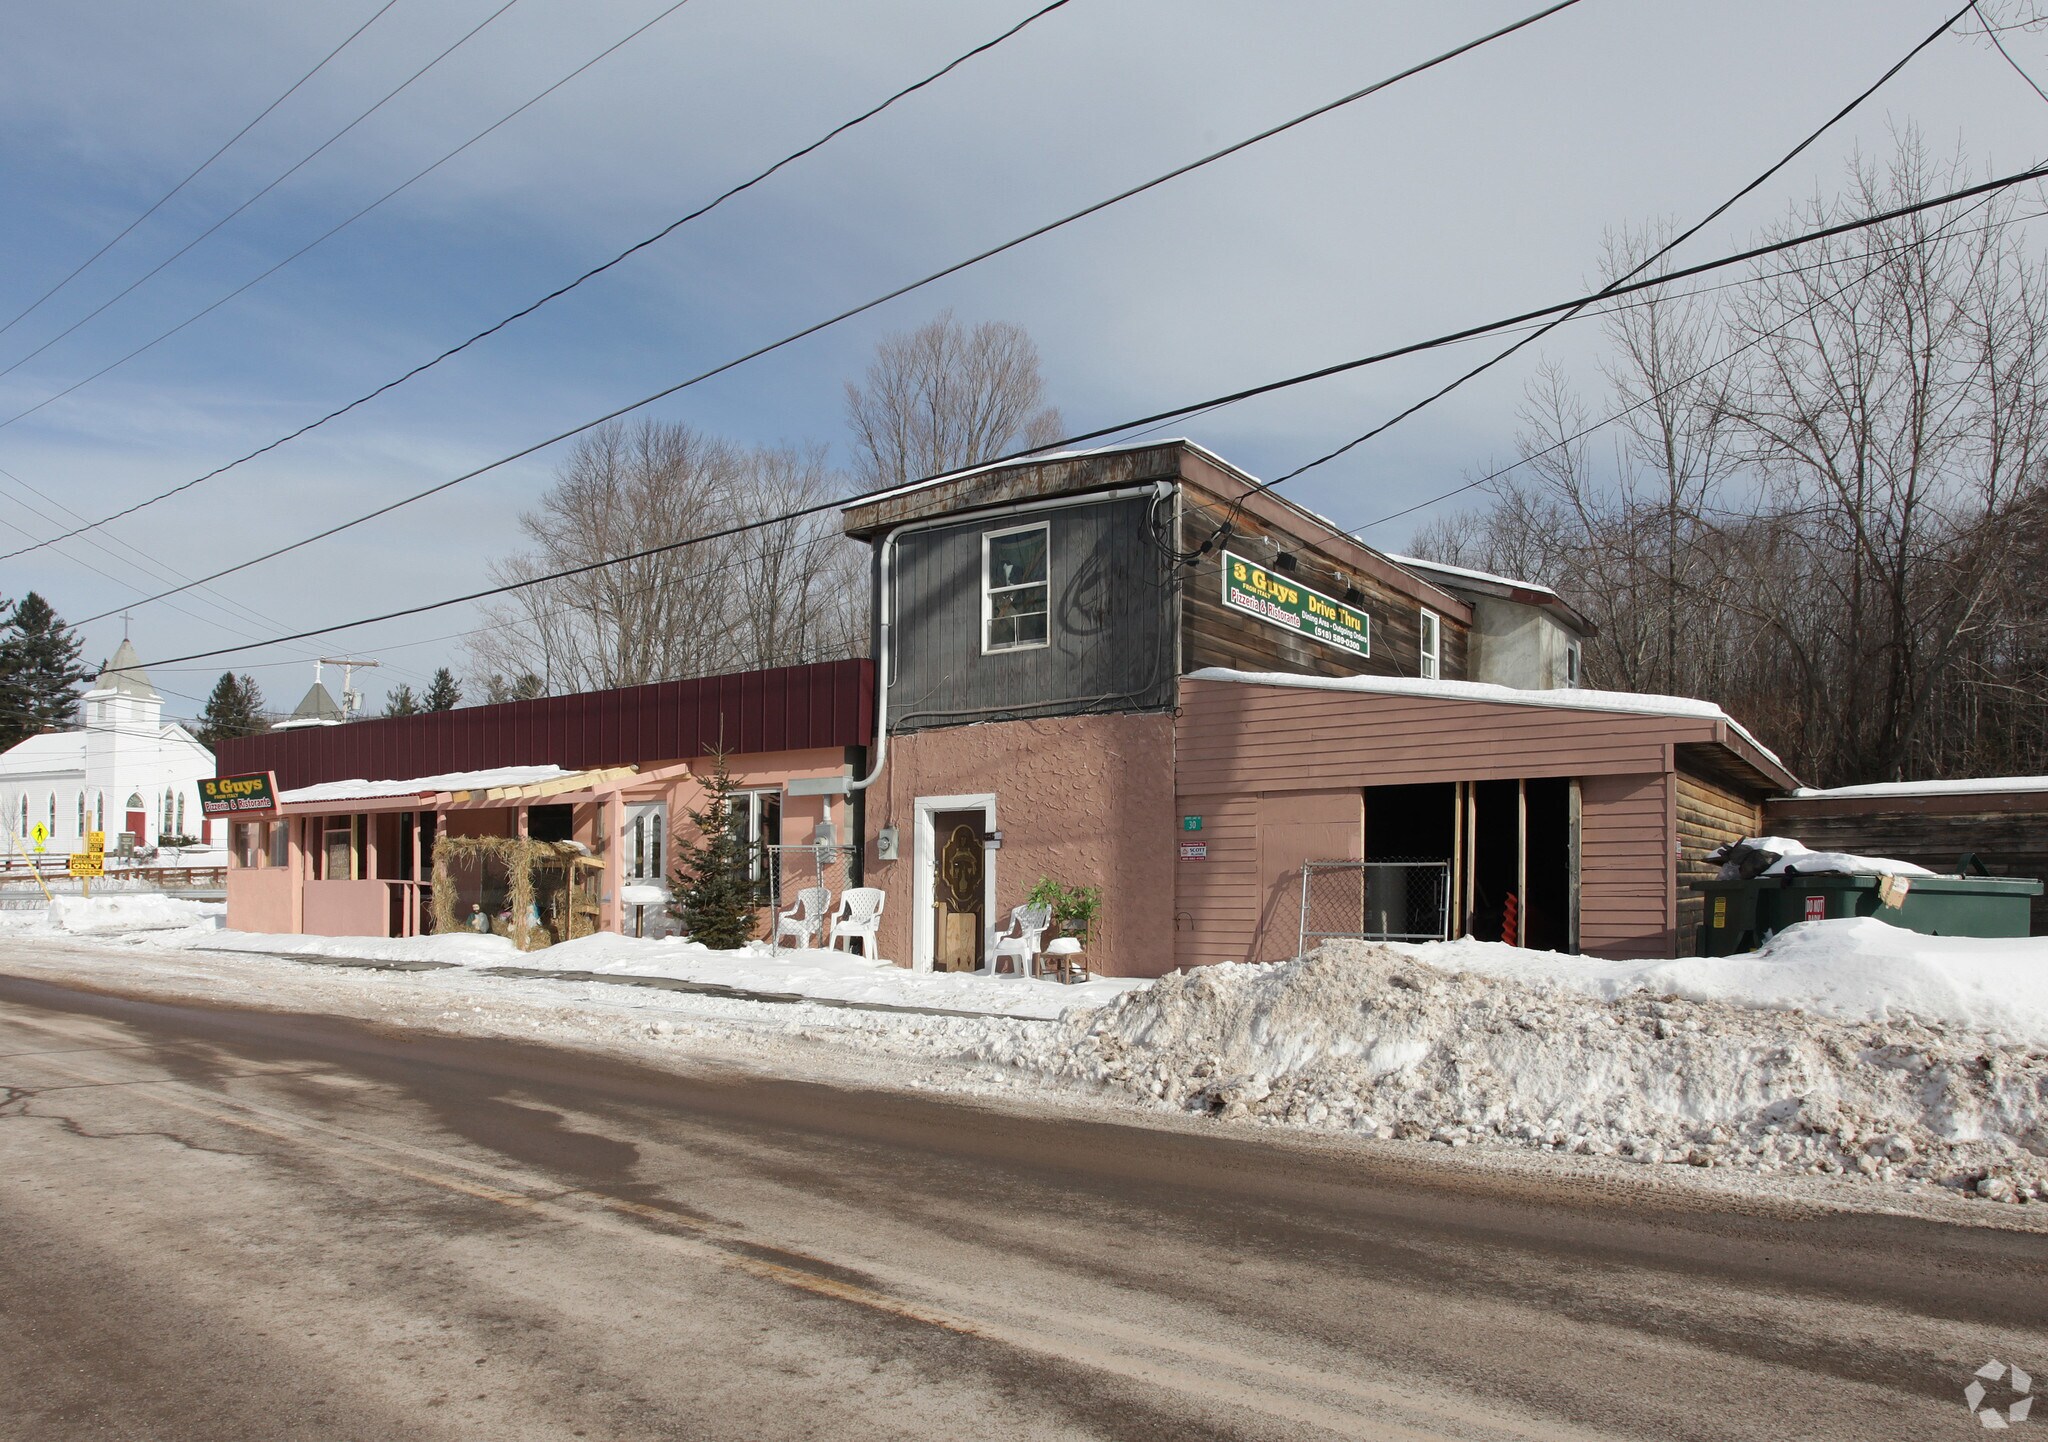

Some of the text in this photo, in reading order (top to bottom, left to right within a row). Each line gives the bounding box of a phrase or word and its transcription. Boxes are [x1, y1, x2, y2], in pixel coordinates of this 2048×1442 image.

[1233, 562, 1298, 604] 3 Guys
[1243, 583, 1272, 599] FROM ITALY
[1231, 587, 1301, 628] Pizzeria & Ristorante
[1308, 595, 1361, 631] Drive Thru
[1302, 610, 1318, 625] Dining
[1318, 617, 1329, 628] Area
[1333, 623, 1353, 639] Outgoing
[1353, 631, 1367, 643] Orders
[1315, 626, 1332, 640] (518)
[206, 779, 263, 795] 3 Guys
[204, 796, 271, 812] Pizzeria & Ristorante
[1805, 899, 1824, 912] DO NOT
